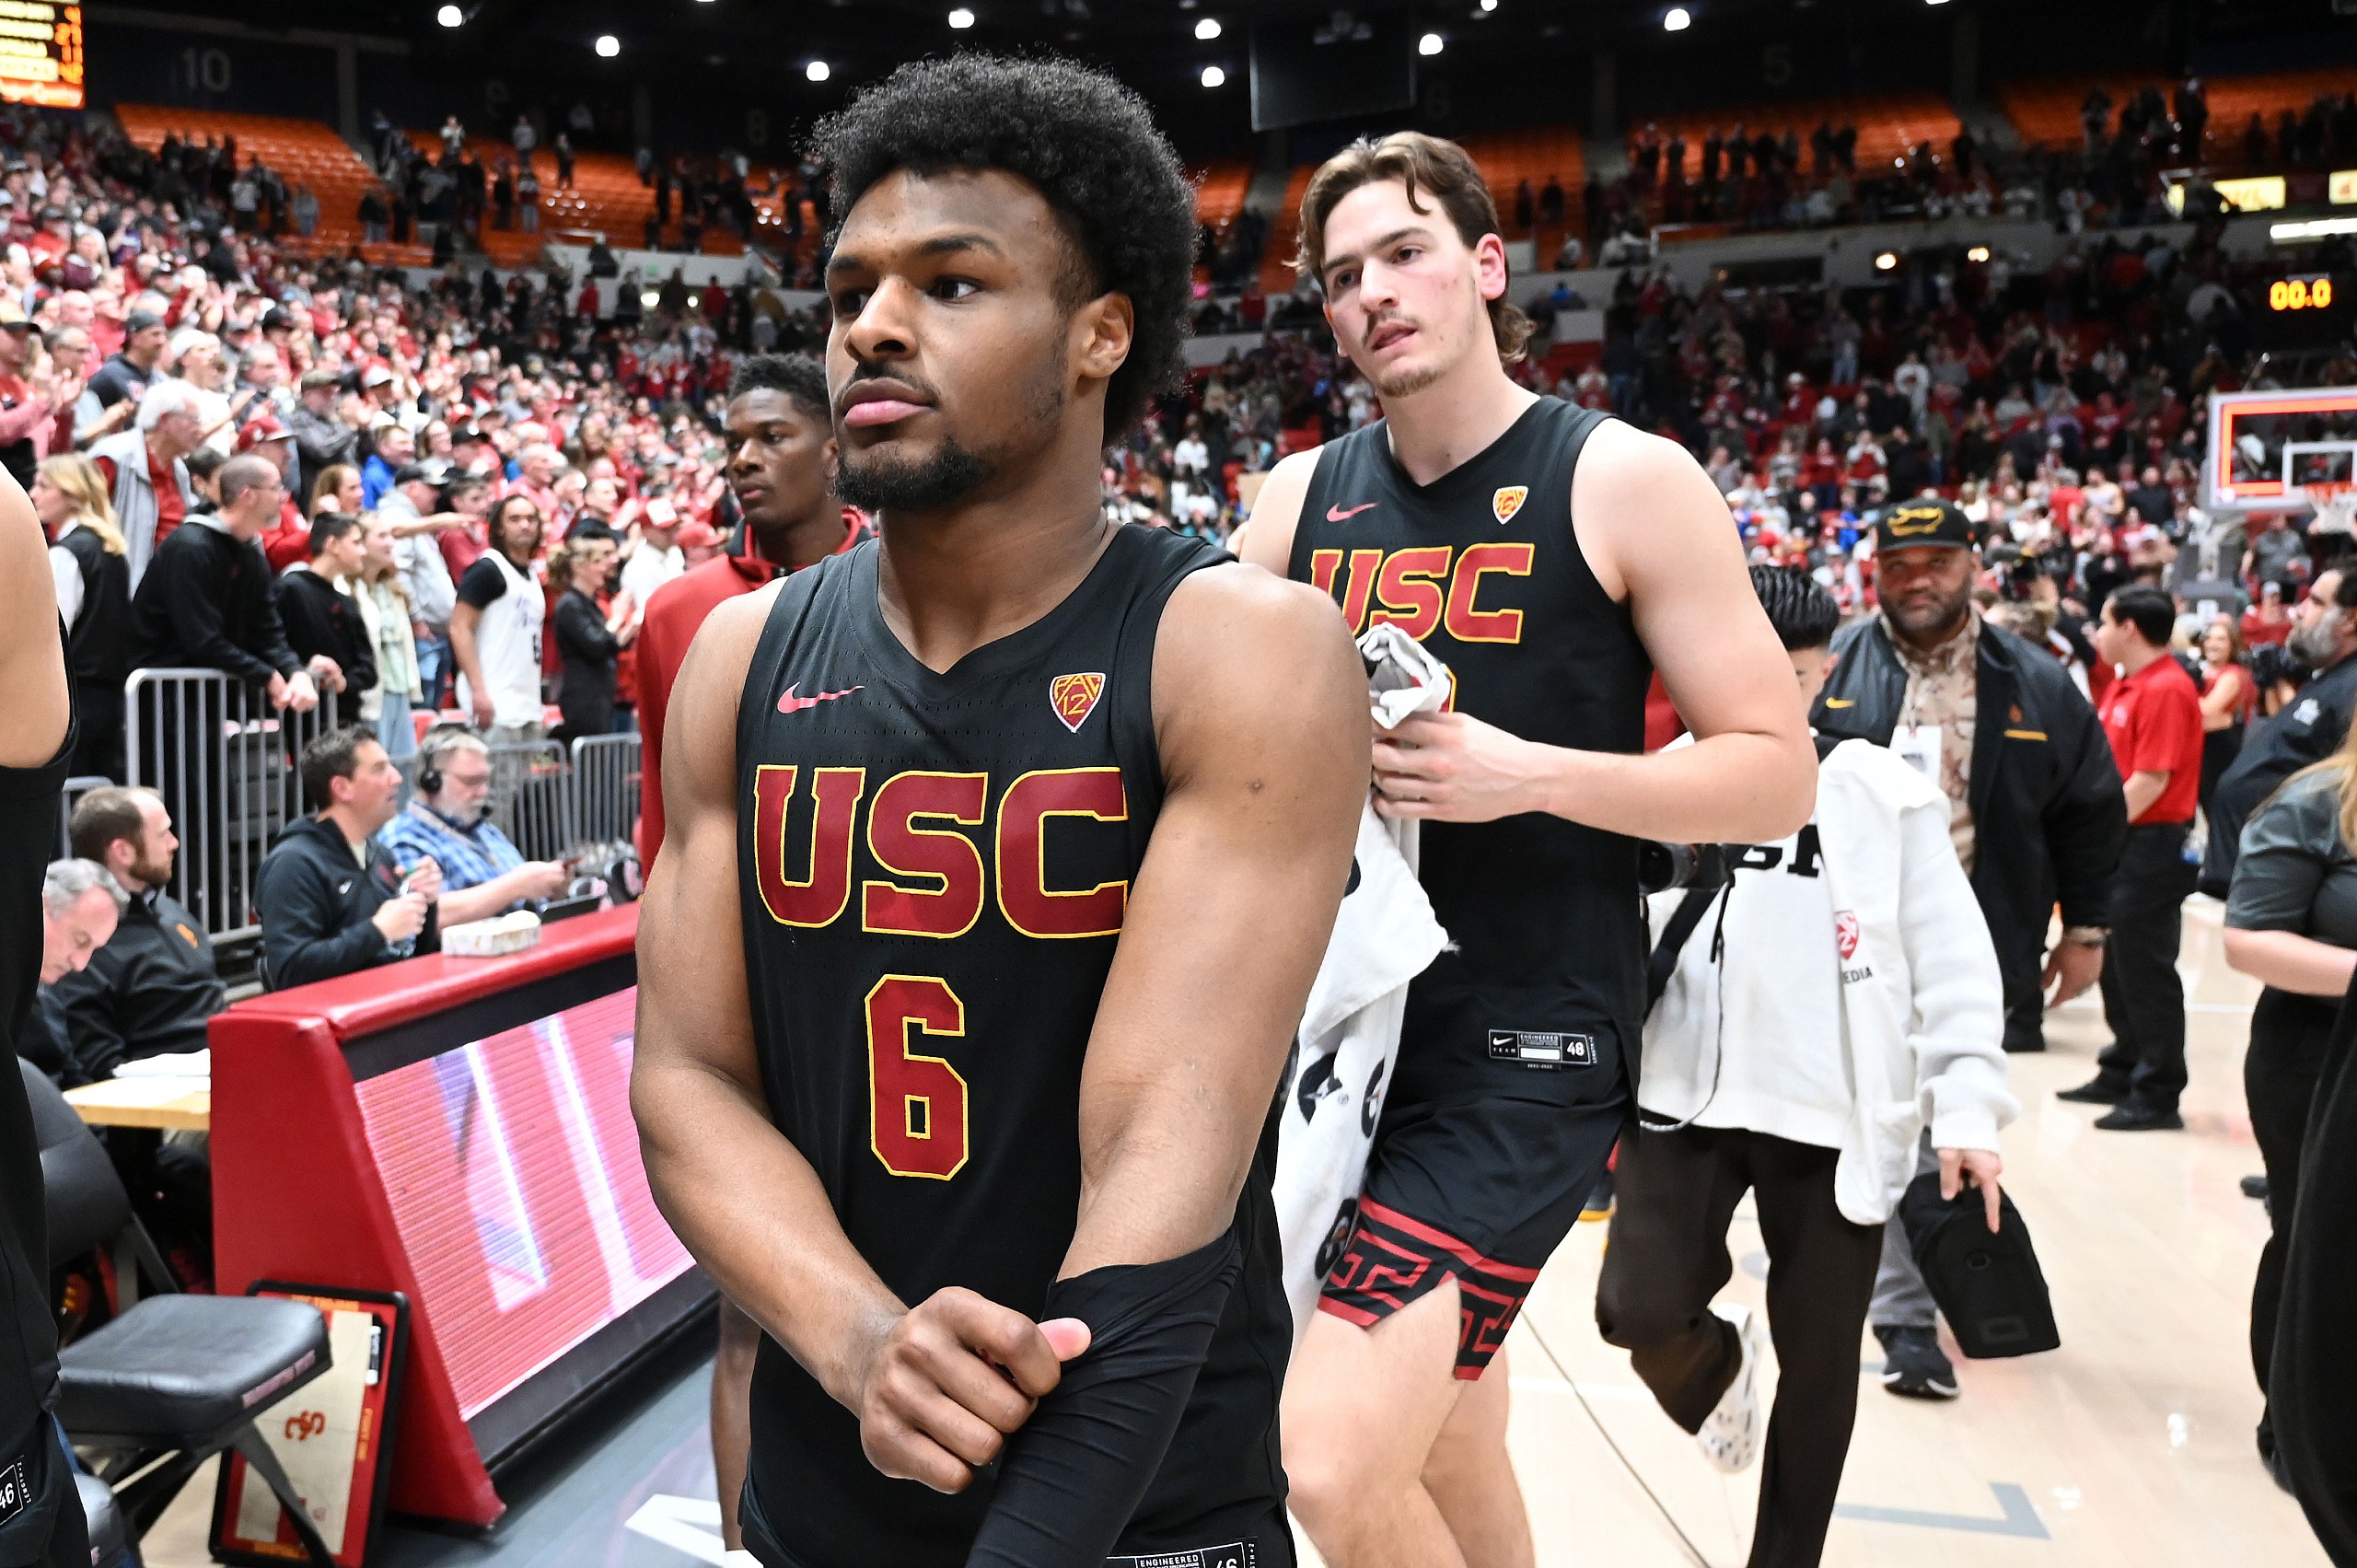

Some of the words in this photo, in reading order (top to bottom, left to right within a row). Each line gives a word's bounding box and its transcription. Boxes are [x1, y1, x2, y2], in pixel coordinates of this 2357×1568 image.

[182, 48, 232, 90] 10
[2270, 278, 2331, 310] 00.0
[1310, 542, 1535, 644] USC
[1053, 675, 1102, 706] PAC
[1062, 693, 1087, 715] 12
[753, 764, 1128, 939] USC
[1842, 967, 1873, 983] EDIA
[1567, 1042, 1585, 1056] 48
[865, 973, 969, 1181] 6
[1141, 1555, 1199, 1567] ENGINEERED
